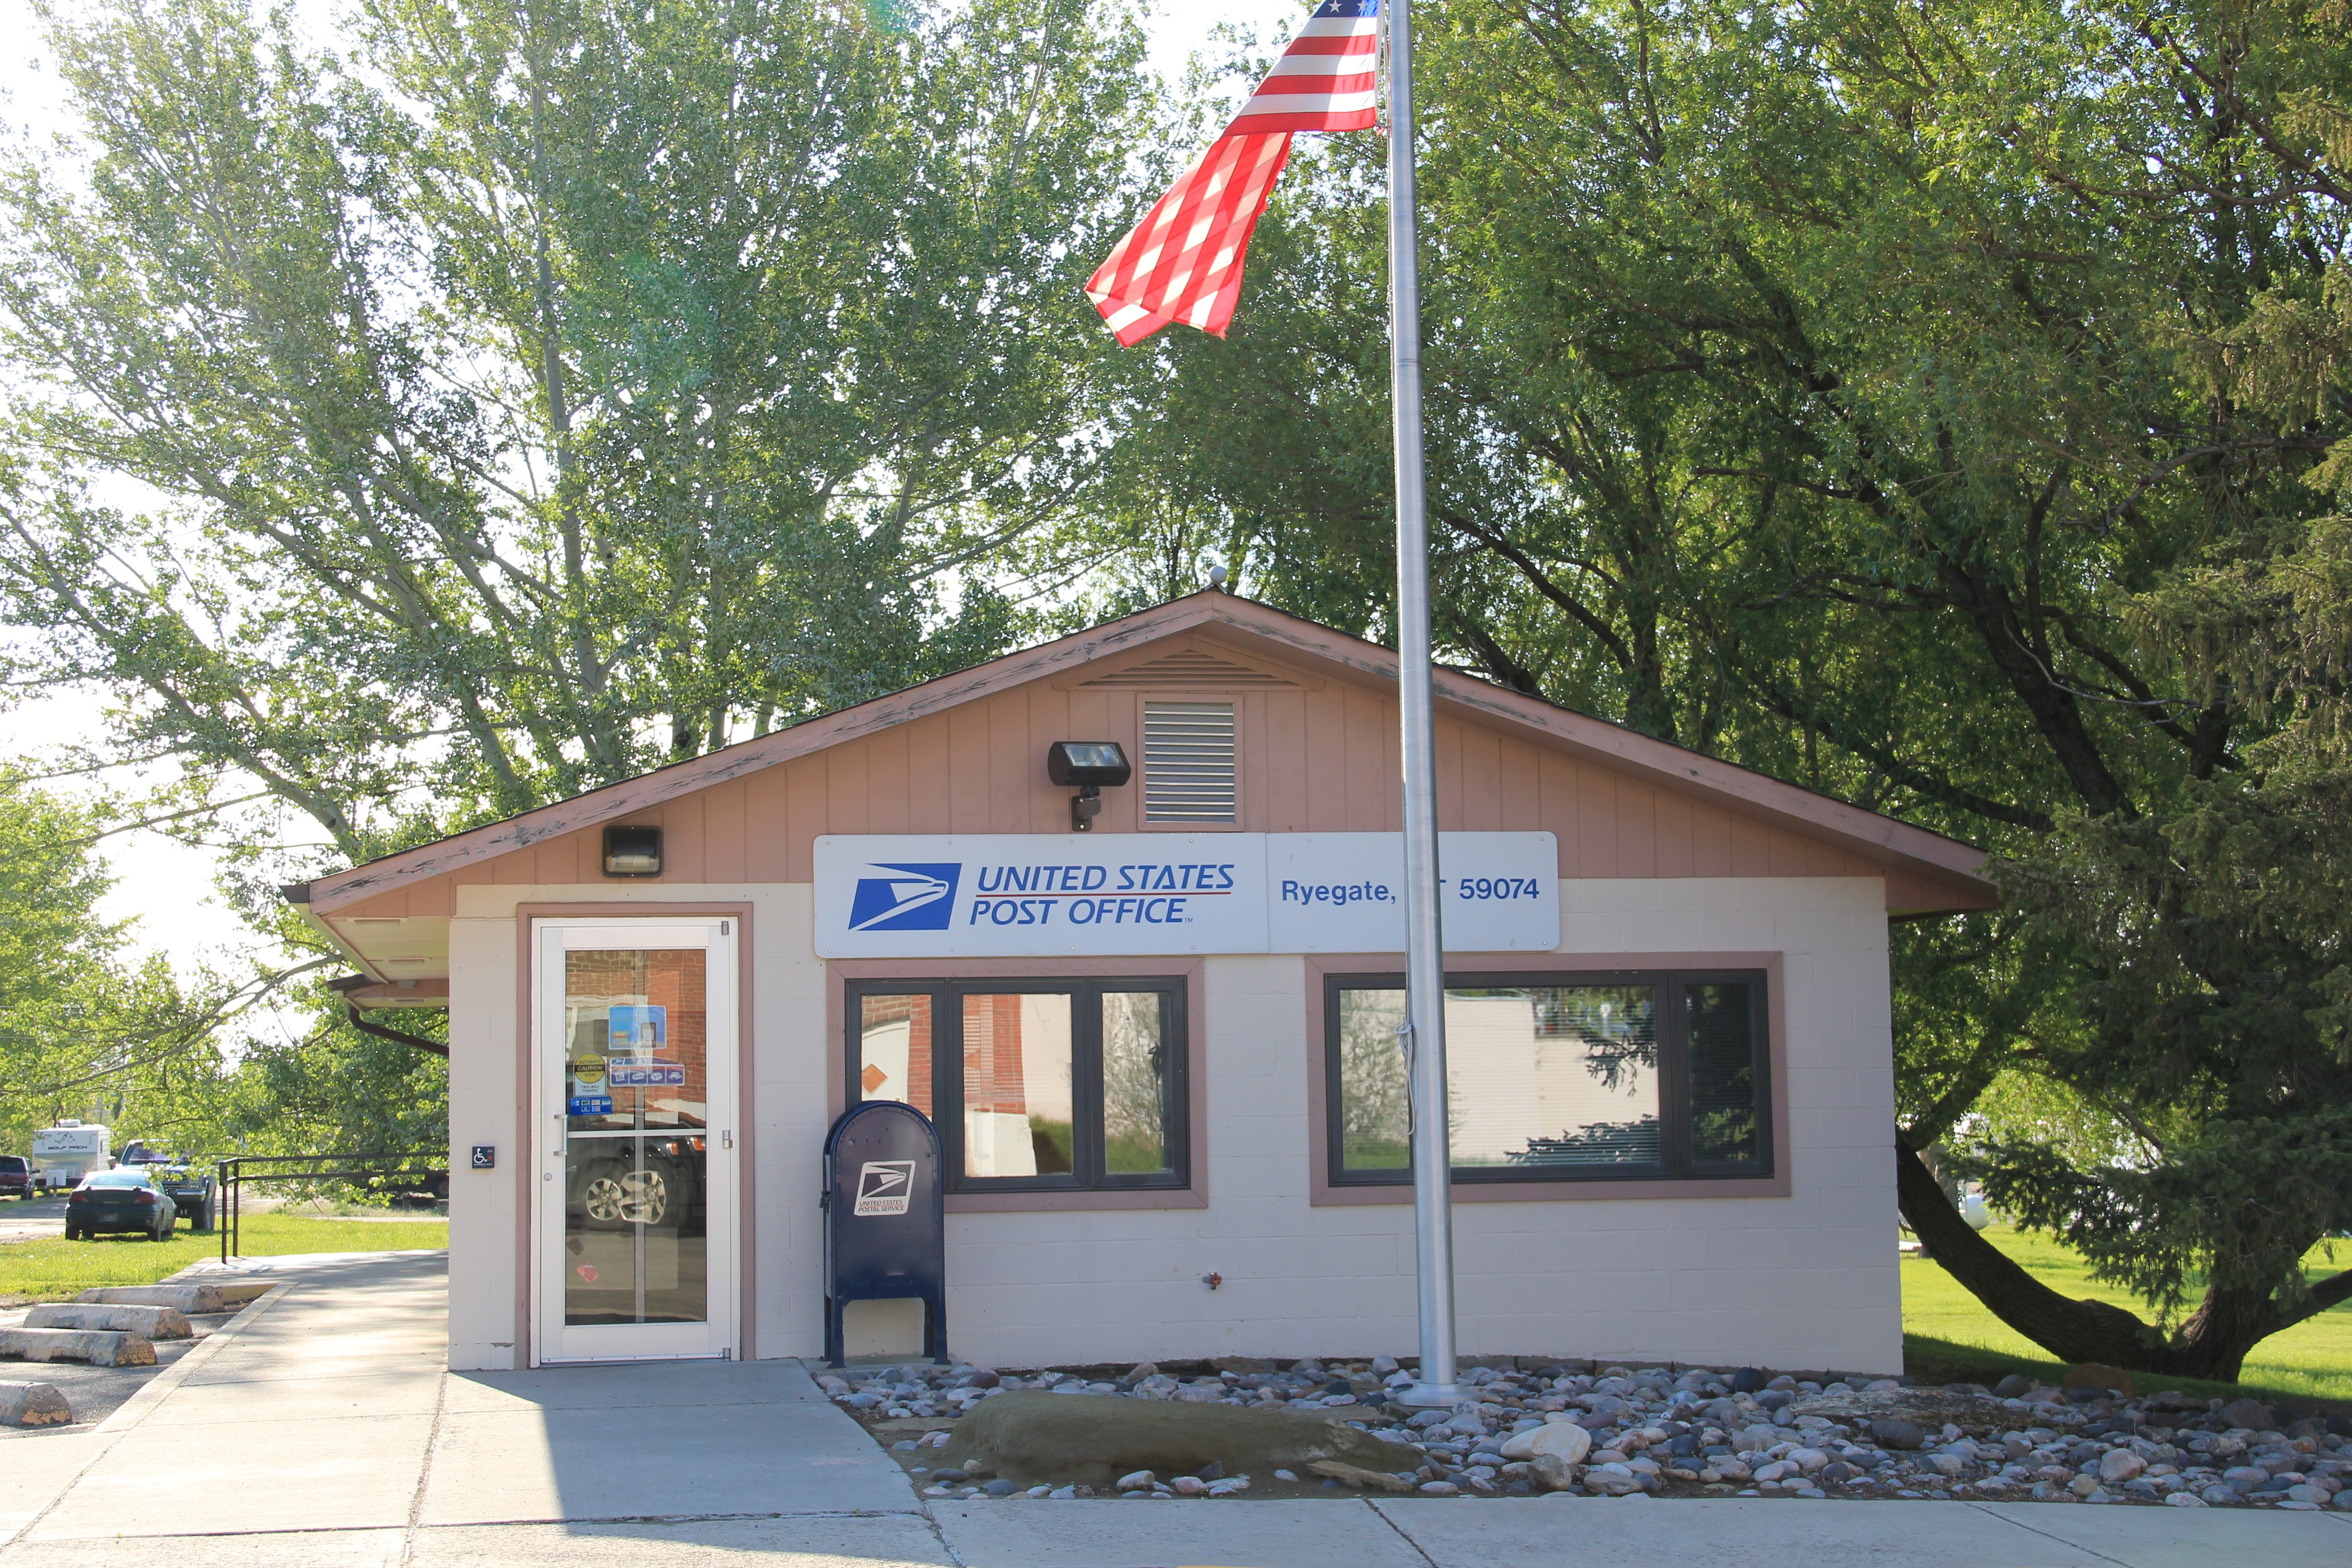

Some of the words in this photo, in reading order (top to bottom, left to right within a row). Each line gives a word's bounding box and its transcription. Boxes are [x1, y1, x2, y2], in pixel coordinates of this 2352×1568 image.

[978, 865, 1107, 892] UNITED
[1116, 864, 1235, 890] STATES
[1282, 880, 1396, 906] Ryegate,
[1459, 878, 1539, 900] 59074
[970, 899, 1058, 925] POST
[1068, 898, 1186, 924] OFFICE
